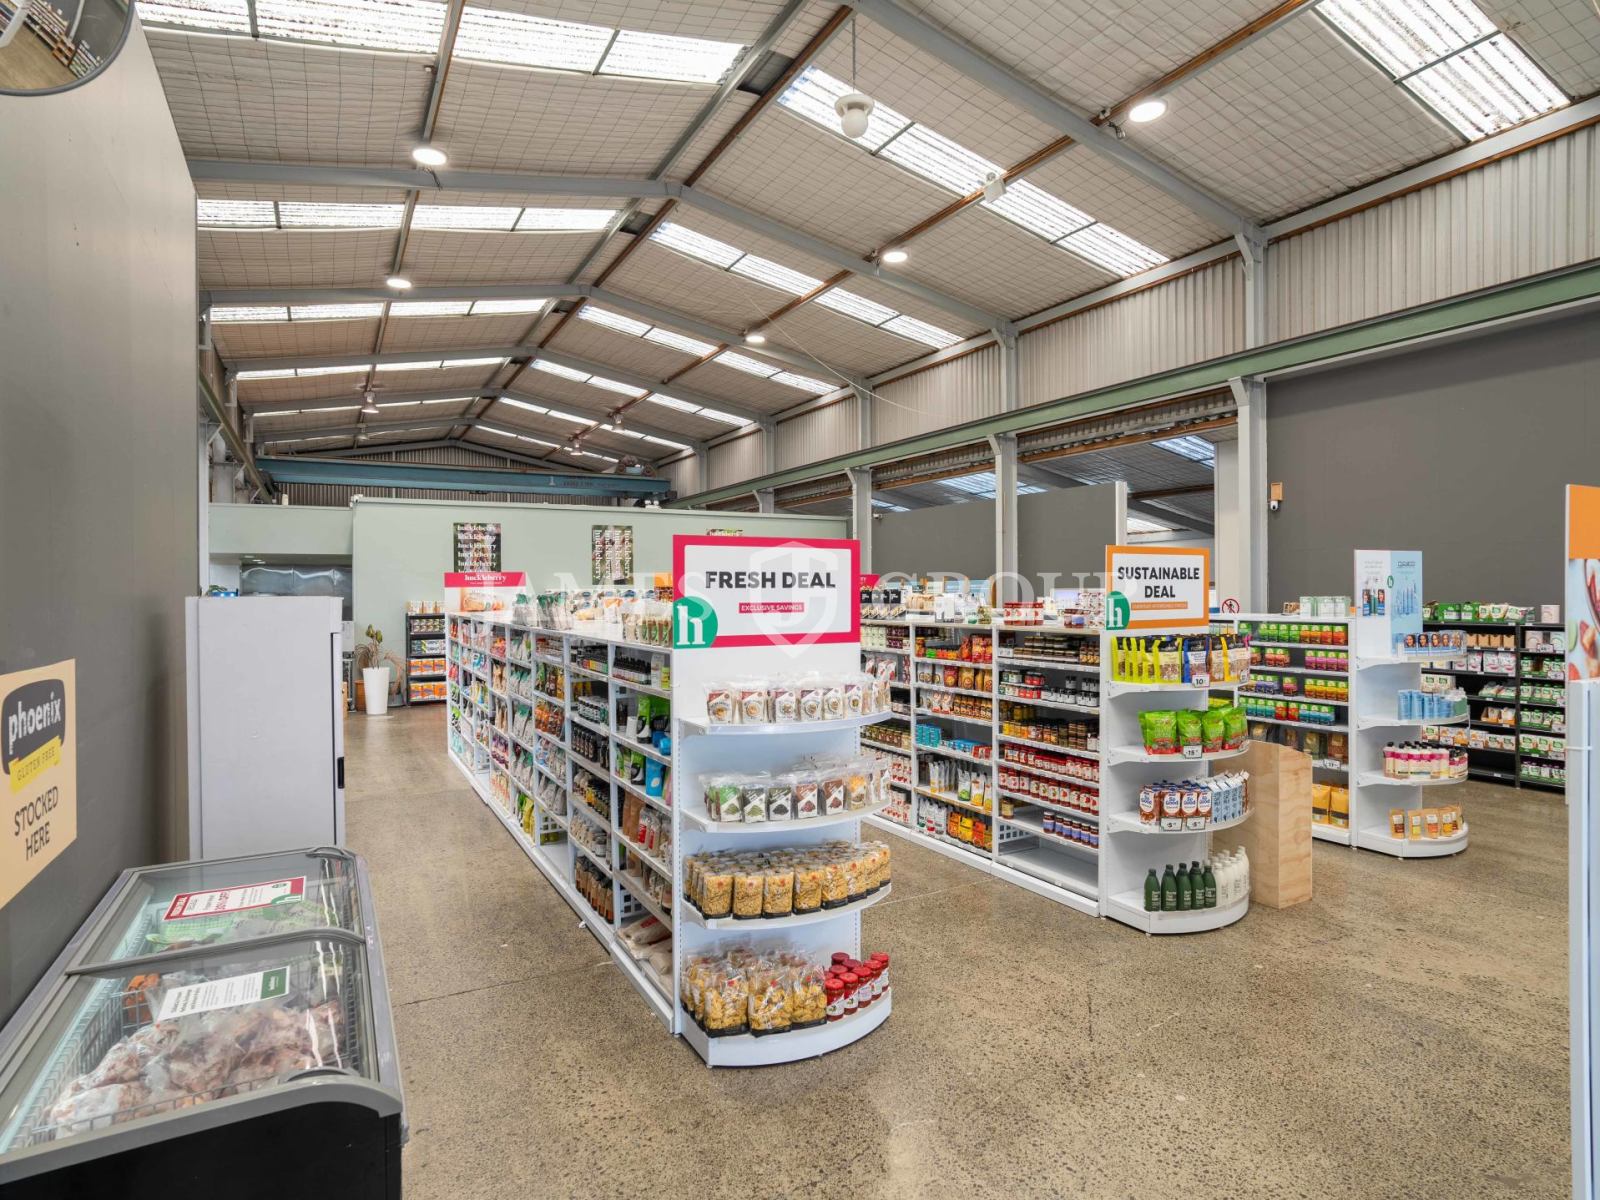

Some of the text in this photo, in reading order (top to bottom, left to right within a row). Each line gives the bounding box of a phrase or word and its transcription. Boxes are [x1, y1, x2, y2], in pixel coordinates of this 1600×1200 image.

[464, 574, 506, 582] huckleberry
[705, 571, 836, 589] FRESH DEAL
[1117, 566, 1200, 580] SUSTAINABLE
[1144, 585, 1176, 598] DEAL
[676, 604, 706, 645] h
[1108, 597, 1124, 628] h
[8, 691, 62, 756] phoenix
[16, 746, 56, 782] GLUTEN FREE
[14, 785, 59, 837] STOCKED
[25, 820, 51, 862] HERE
